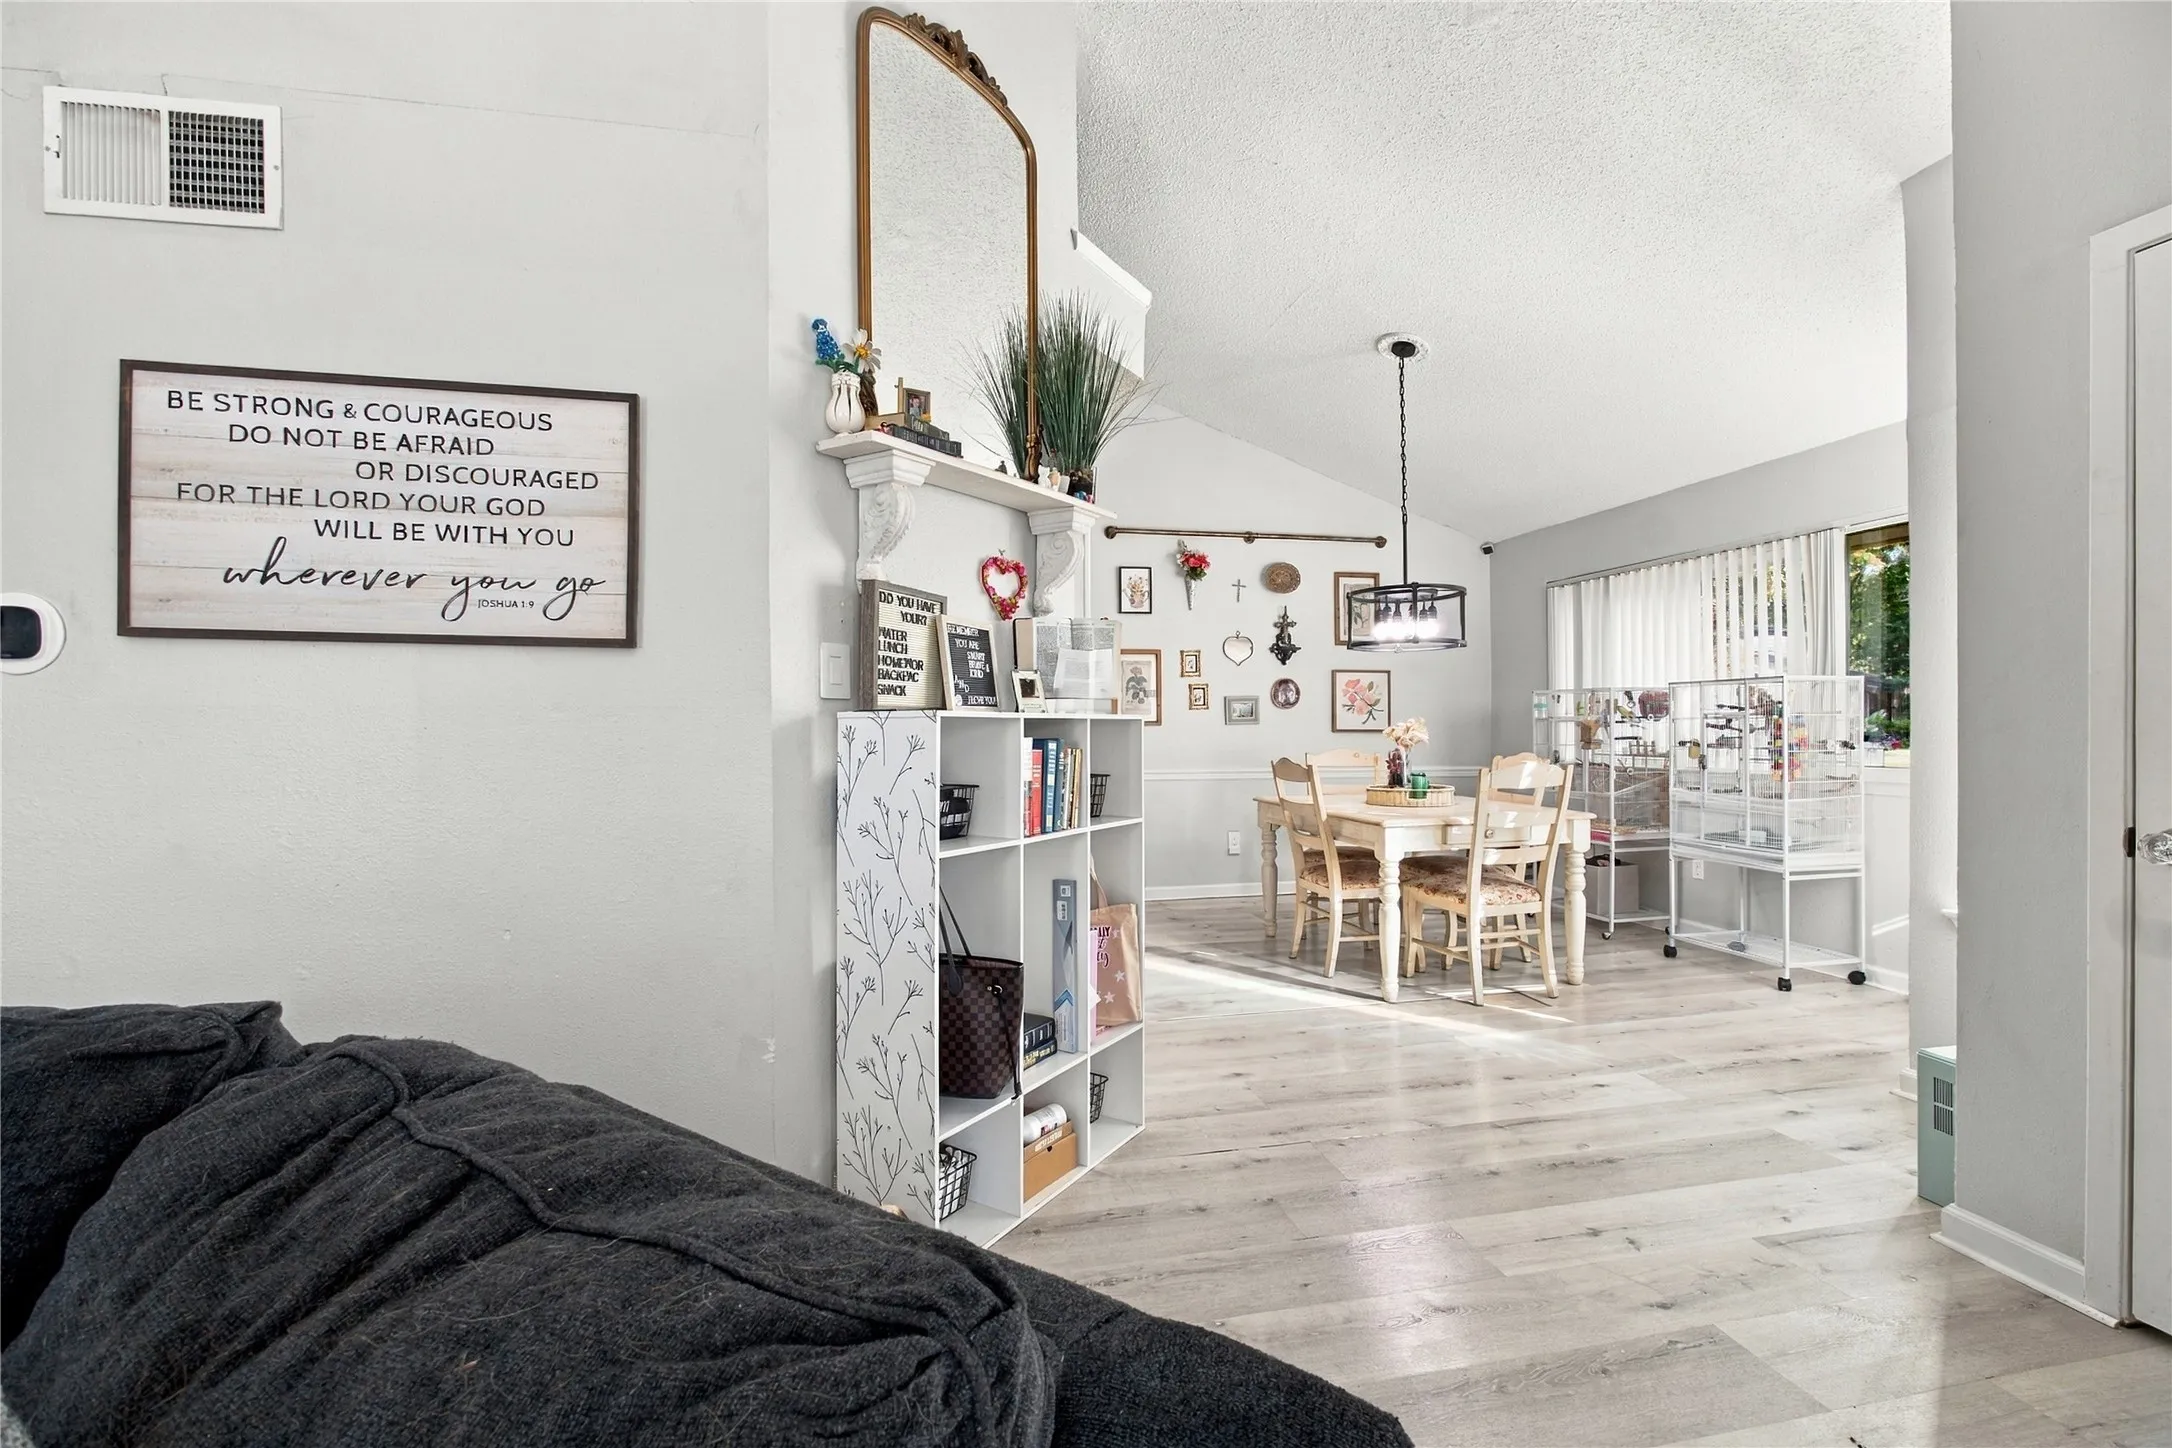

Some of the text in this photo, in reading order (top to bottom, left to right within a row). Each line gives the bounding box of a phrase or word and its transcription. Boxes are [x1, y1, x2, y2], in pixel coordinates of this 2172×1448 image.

[167, 390, 554, 432] BE STRONG & COURAGEOUS
[228, 423, 495, 456] DO NOT BE AFRAID
[355, 461, 599, 490] OR DISCOURAGED
[177, 482, 546, 517] FOR THE LORD YOUR GOD
[313, 518, 575, 547] WILL BE WITH YOU
[222, 536, 607, 622] wherever you go
[477, 599, 535, 609] JOSHUA 1:9
[896, 594, 915, 608] YOU
[916, 599, 936, 614] HAVE
[901, 611, 927, 626] YOUR?
[878, 626, 908, 642] WATER
[878, 639, 908, 655] LUNCH
[954, 638, 980, 651] YOU ARE
[877, 668, 920, 683] BACKPAC
[877, 683, 907, 697] SNACK
